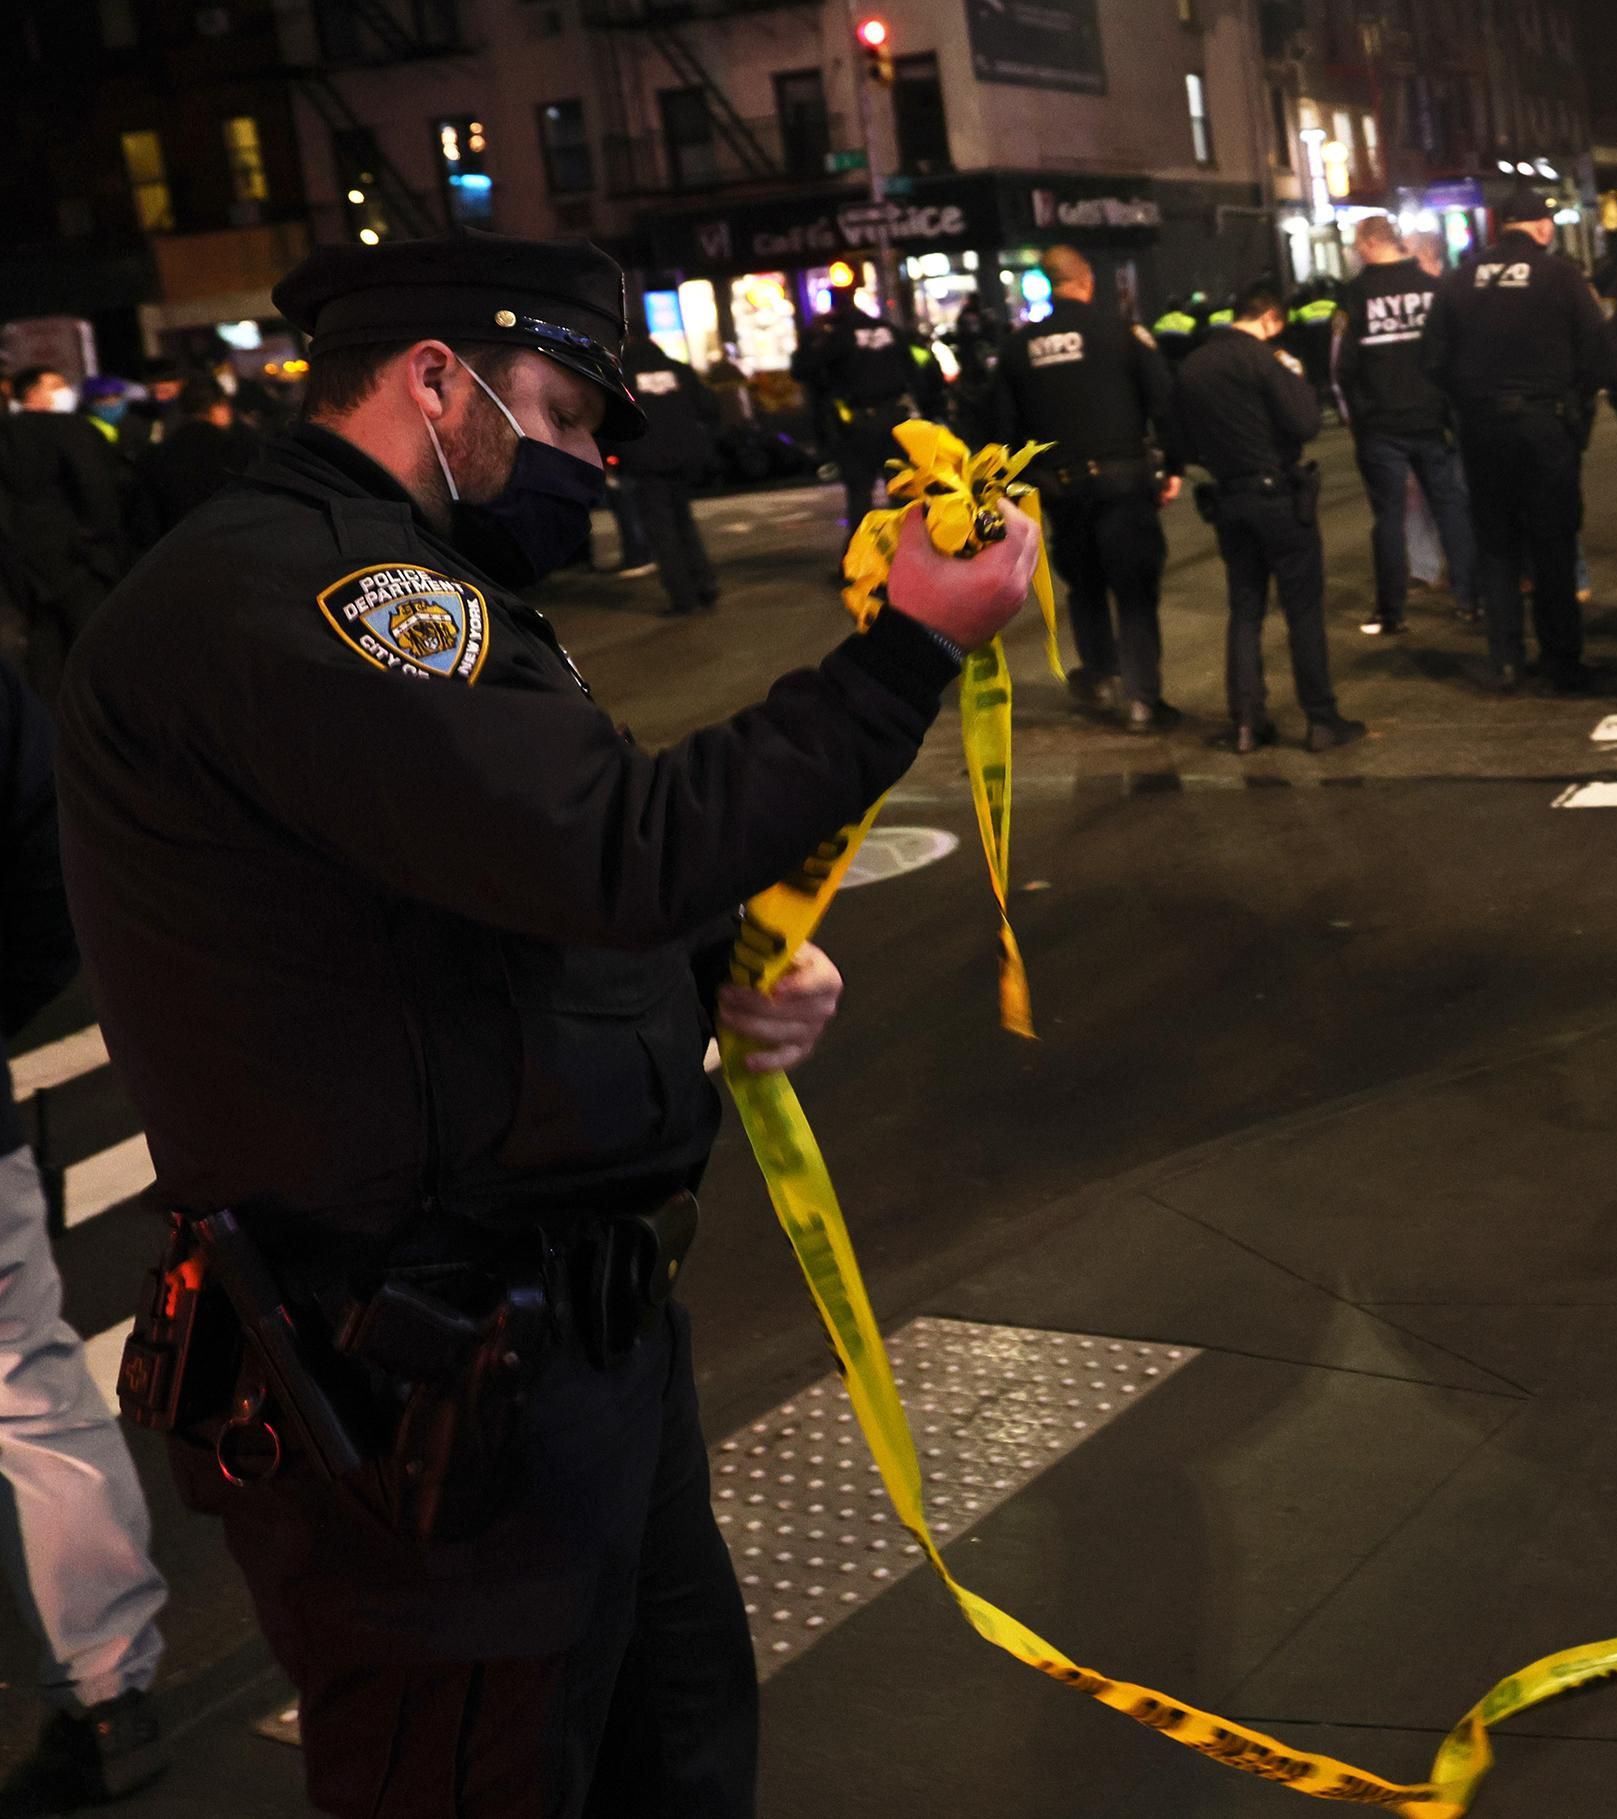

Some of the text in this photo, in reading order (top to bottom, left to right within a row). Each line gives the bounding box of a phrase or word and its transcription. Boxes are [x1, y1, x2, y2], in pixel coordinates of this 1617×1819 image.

[1368, 313, 1427, 335] POLIC
[1028, 331, 1084, 358] NYPD
[359, 569, 433, 594] POLICE
[342, 578, 465, 623] DEPARTMENT
[359, 634, 402, 668] CITY
[457, 598, 483, 679] NEW YORK
